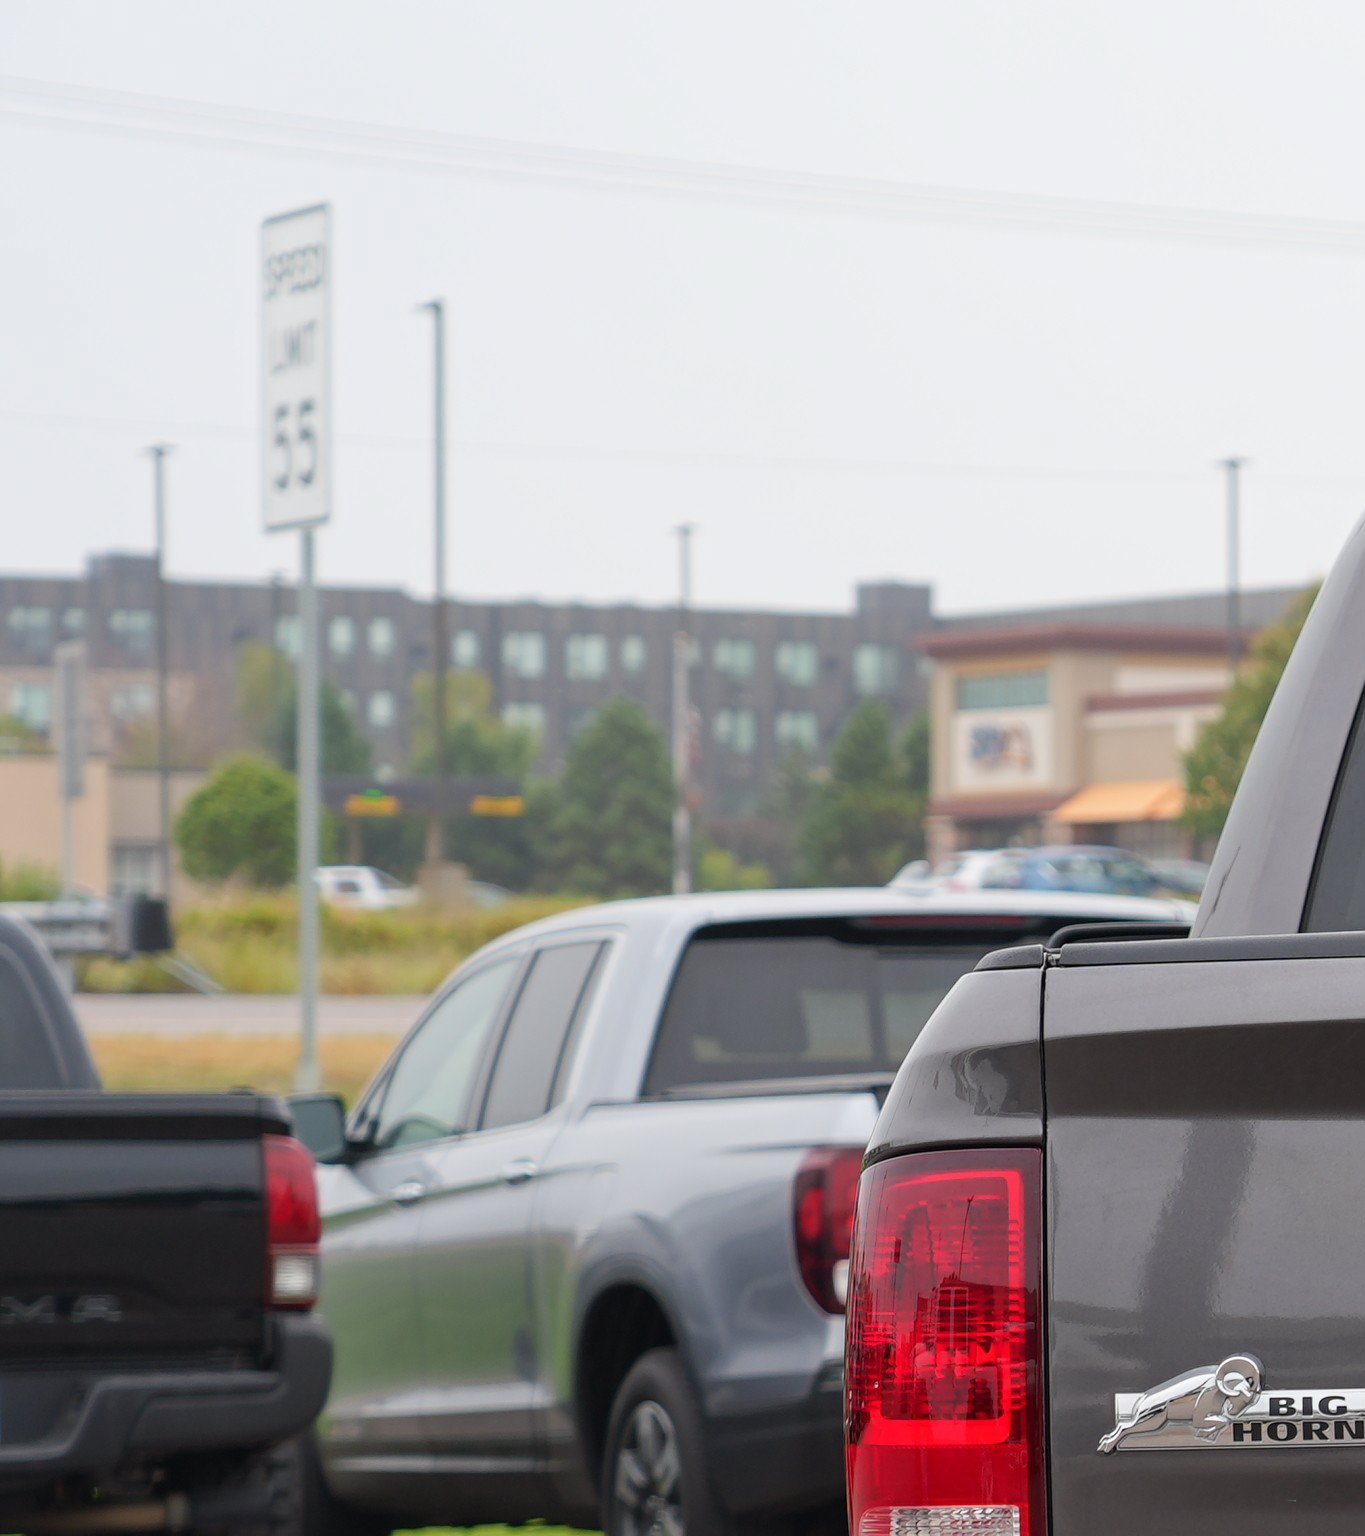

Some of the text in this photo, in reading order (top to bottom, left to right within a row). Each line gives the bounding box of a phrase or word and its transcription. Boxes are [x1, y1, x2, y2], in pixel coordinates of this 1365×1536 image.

[263, 242, 325, 301] SPEED
[269, 319, 318, 375] LIMIT
[273, 397, 318, 492] 55
[1233, 1420, 1365, 1442] HORN
[1269, 1396, 1348, 1417] BIG
